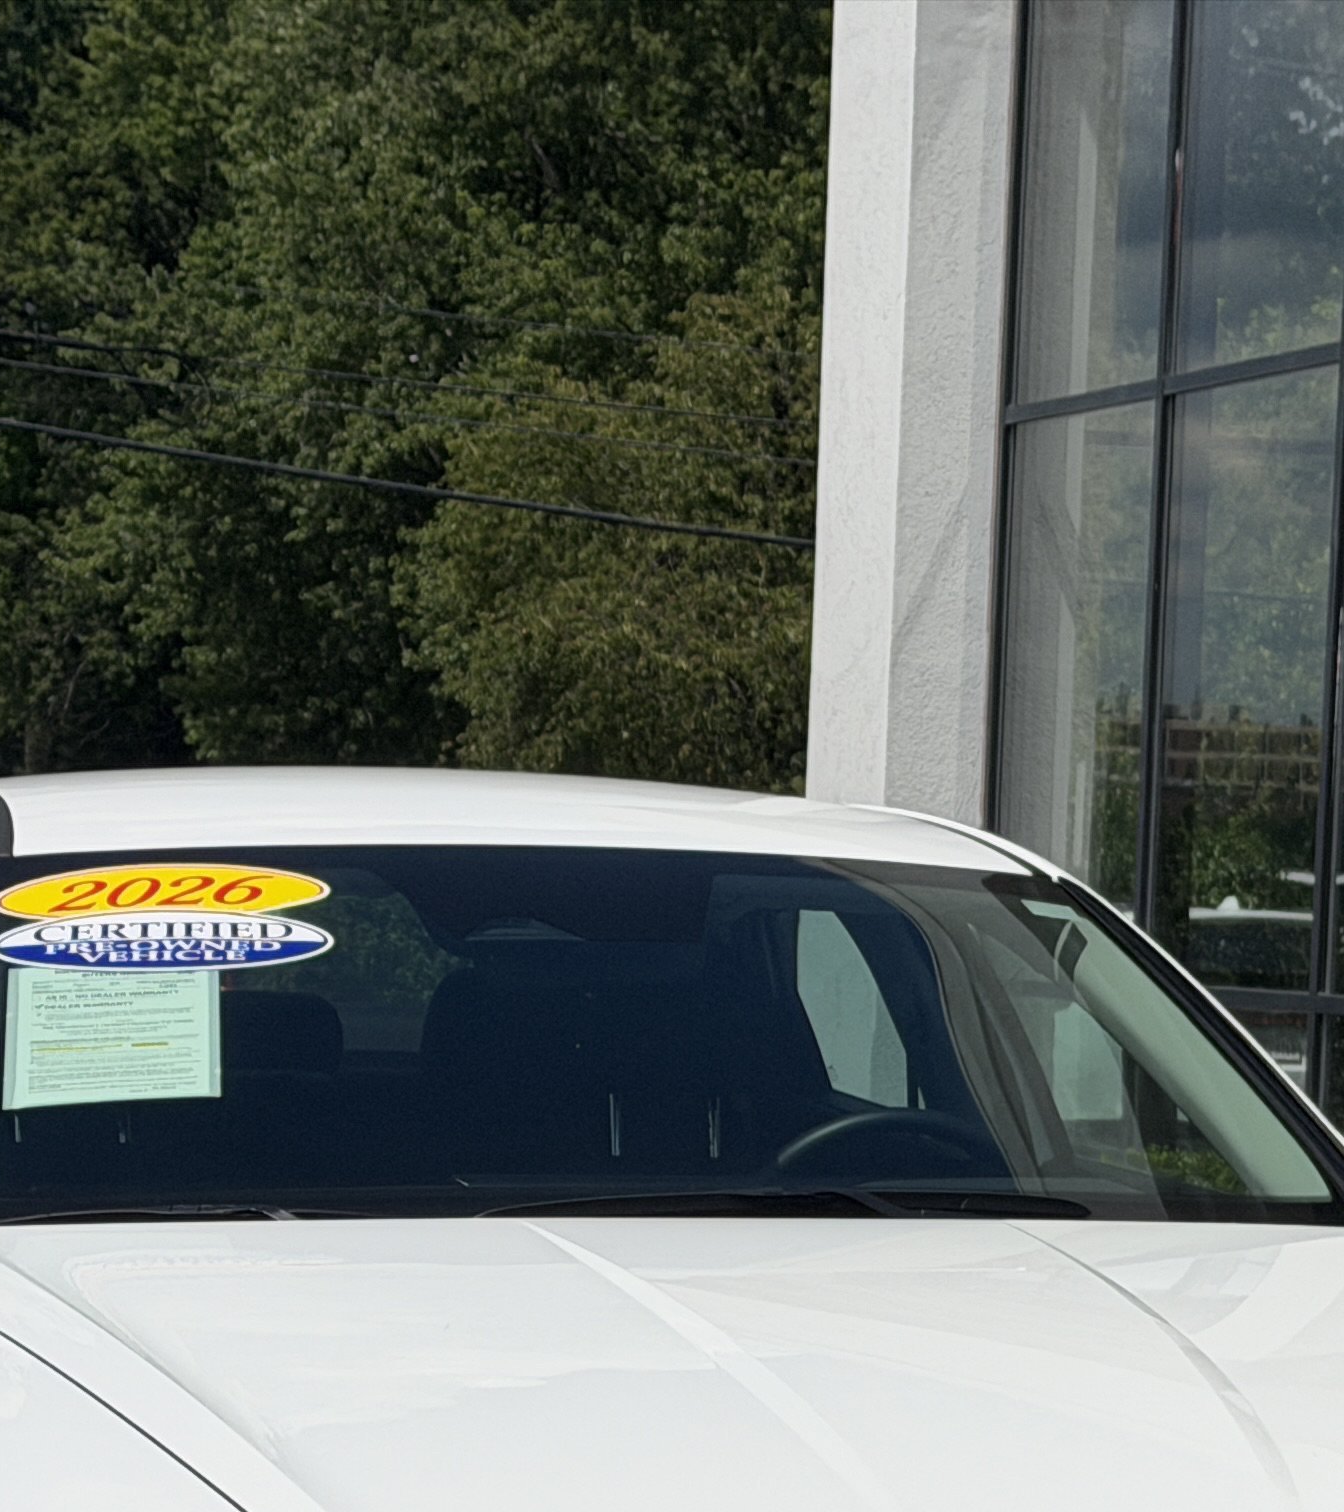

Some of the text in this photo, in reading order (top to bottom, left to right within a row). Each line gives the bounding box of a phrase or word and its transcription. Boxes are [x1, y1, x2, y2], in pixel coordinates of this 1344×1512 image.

[47, 875, 275, 914] 2026
[33, 921, 294, 944] CERTIFIED
[44, 939, 282, 955] PRE-OWNED
[78, 950, 247, 963] VEHICLE
